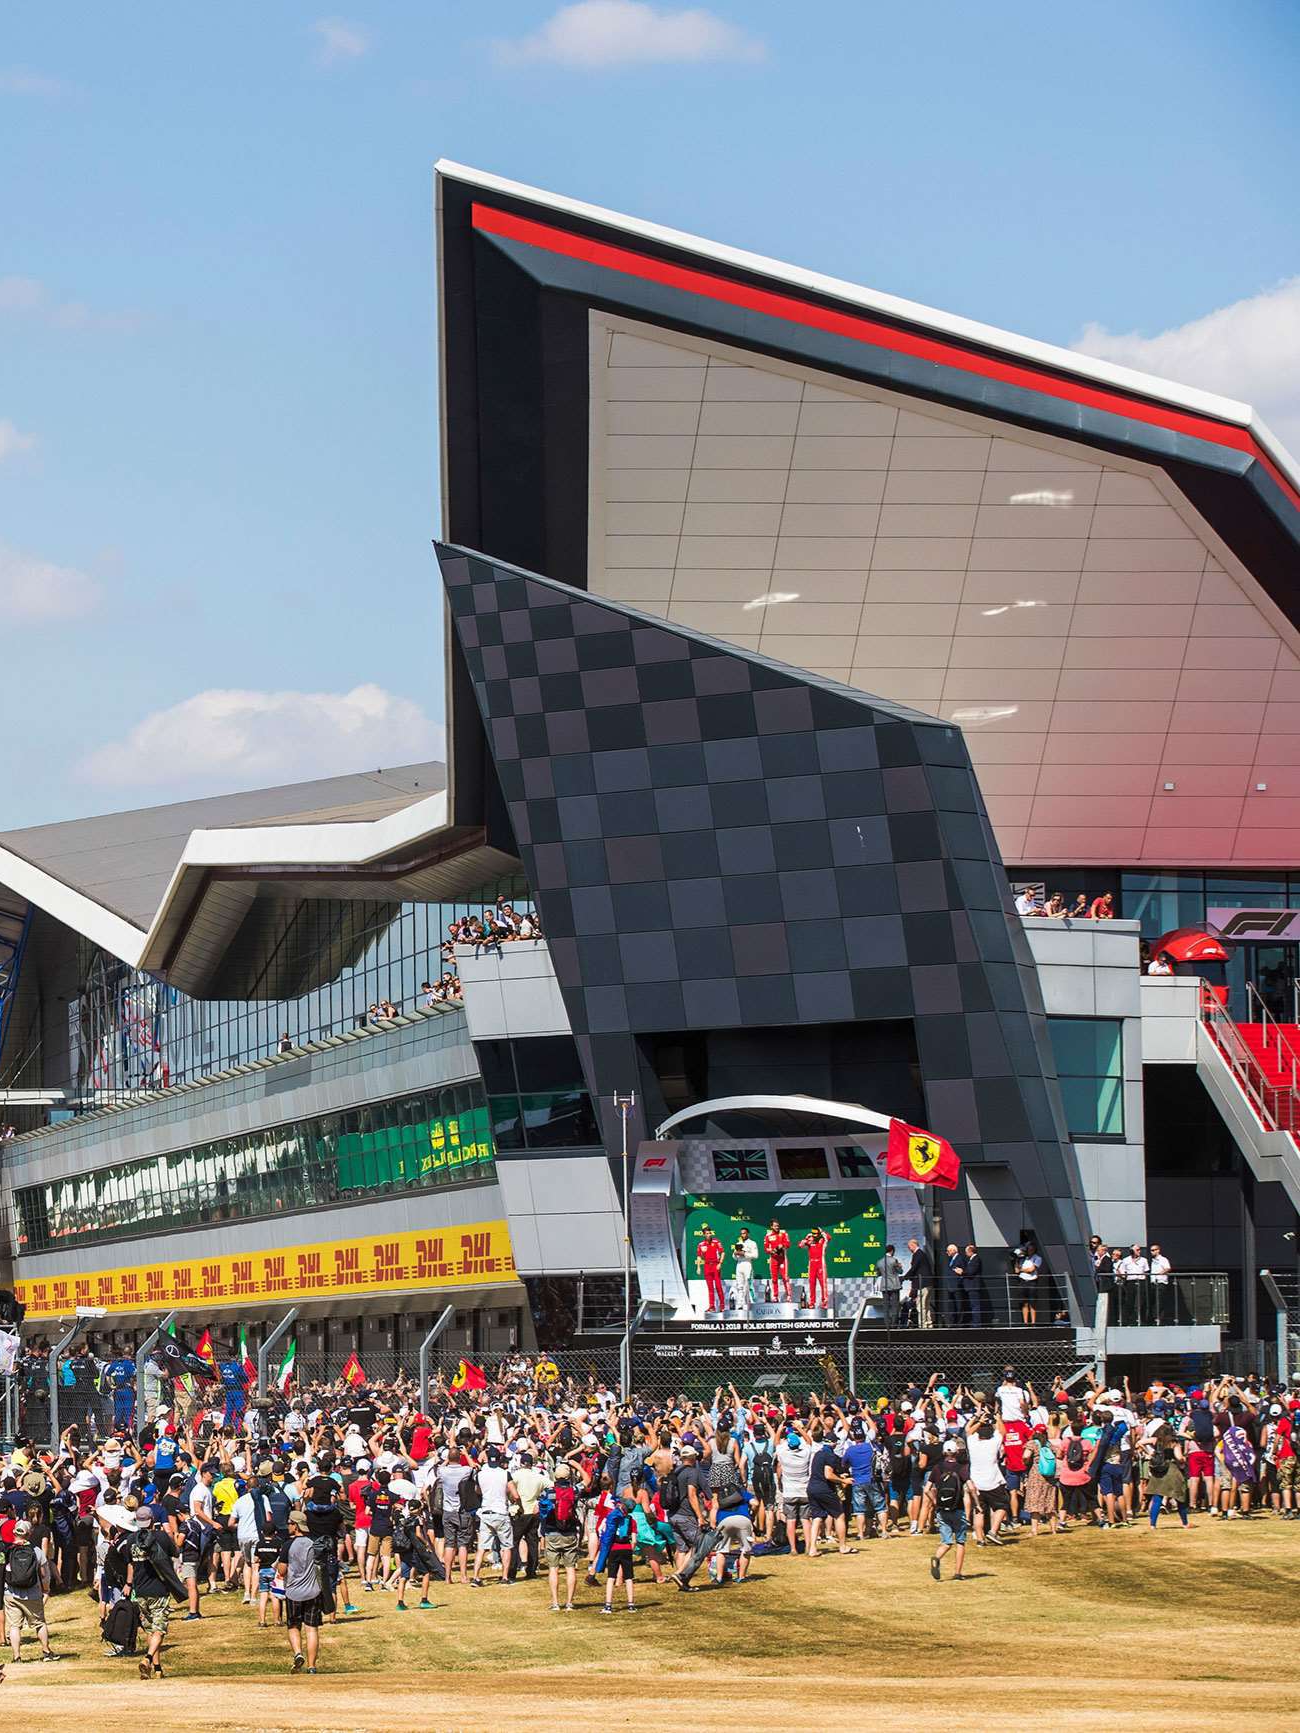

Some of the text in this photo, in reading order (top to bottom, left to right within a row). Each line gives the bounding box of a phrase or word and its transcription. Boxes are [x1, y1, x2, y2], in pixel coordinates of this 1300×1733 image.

[1219, 912, 1299, 936] F1
[774, 1192, 817, 1207] F1
[33, 1284, 48, 1311] DHL
[54, 1282, 70, 1310] DHL
[75, 1280, 93, 1307] DHL
[98, 1276, 116, 1305] DHL
[121, 1274, 140, 1303] DHL
[146, 1270, 166, 1300] DHL
[173, 1268, 194, 1299] DHL
[202, 1265, 224, 1297] DHL
[232, 1261, 256, 1295] DHL
[264, 1256, 289, 1291] DHL
[298, 1252, 324, 1288] DHL
[335, 1248, 362, 1285] DHL
[374, 1243, 403, 1282] DHL
[416, 1238, 447, 1278] DHL
[461, 1232, 495, 1274] DHL
[794, 1321, 821, 1329] GRAND
